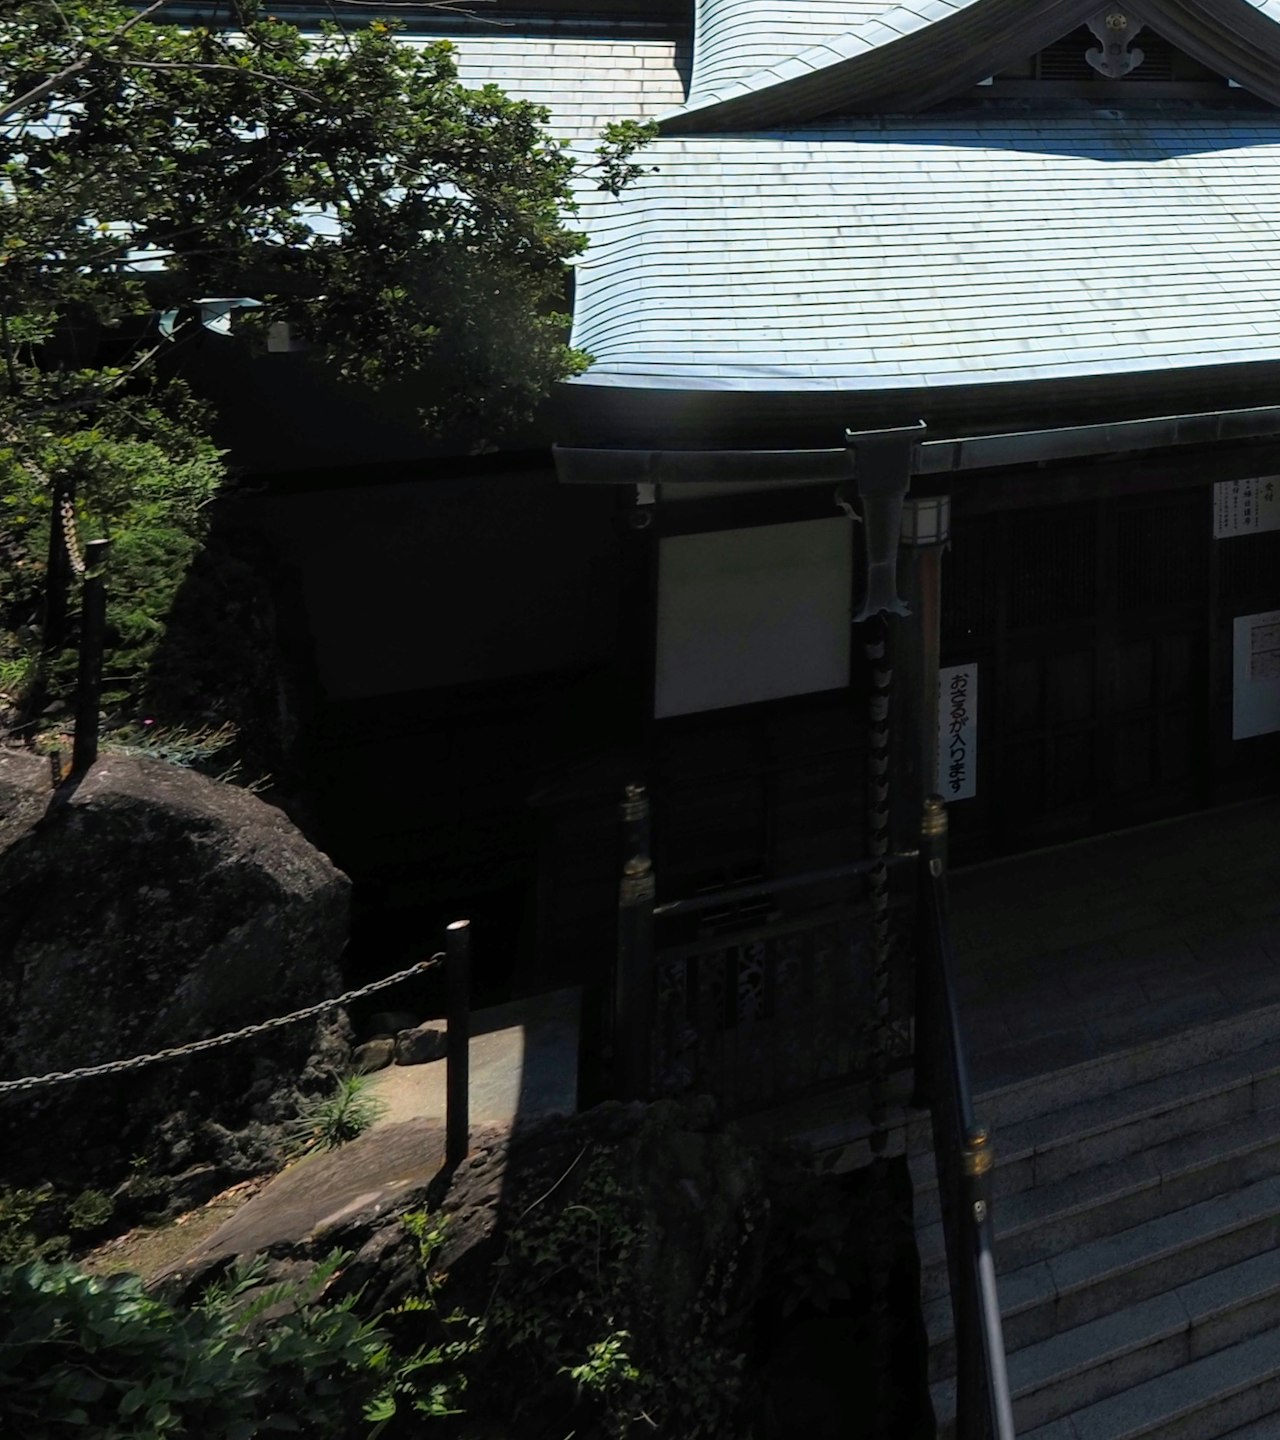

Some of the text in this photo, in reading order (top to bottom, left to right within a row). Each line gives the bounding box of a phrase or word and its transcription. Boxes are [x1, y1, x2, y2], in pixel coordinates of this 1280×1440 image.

[948, 673, 969, 793] おさるが入ります
